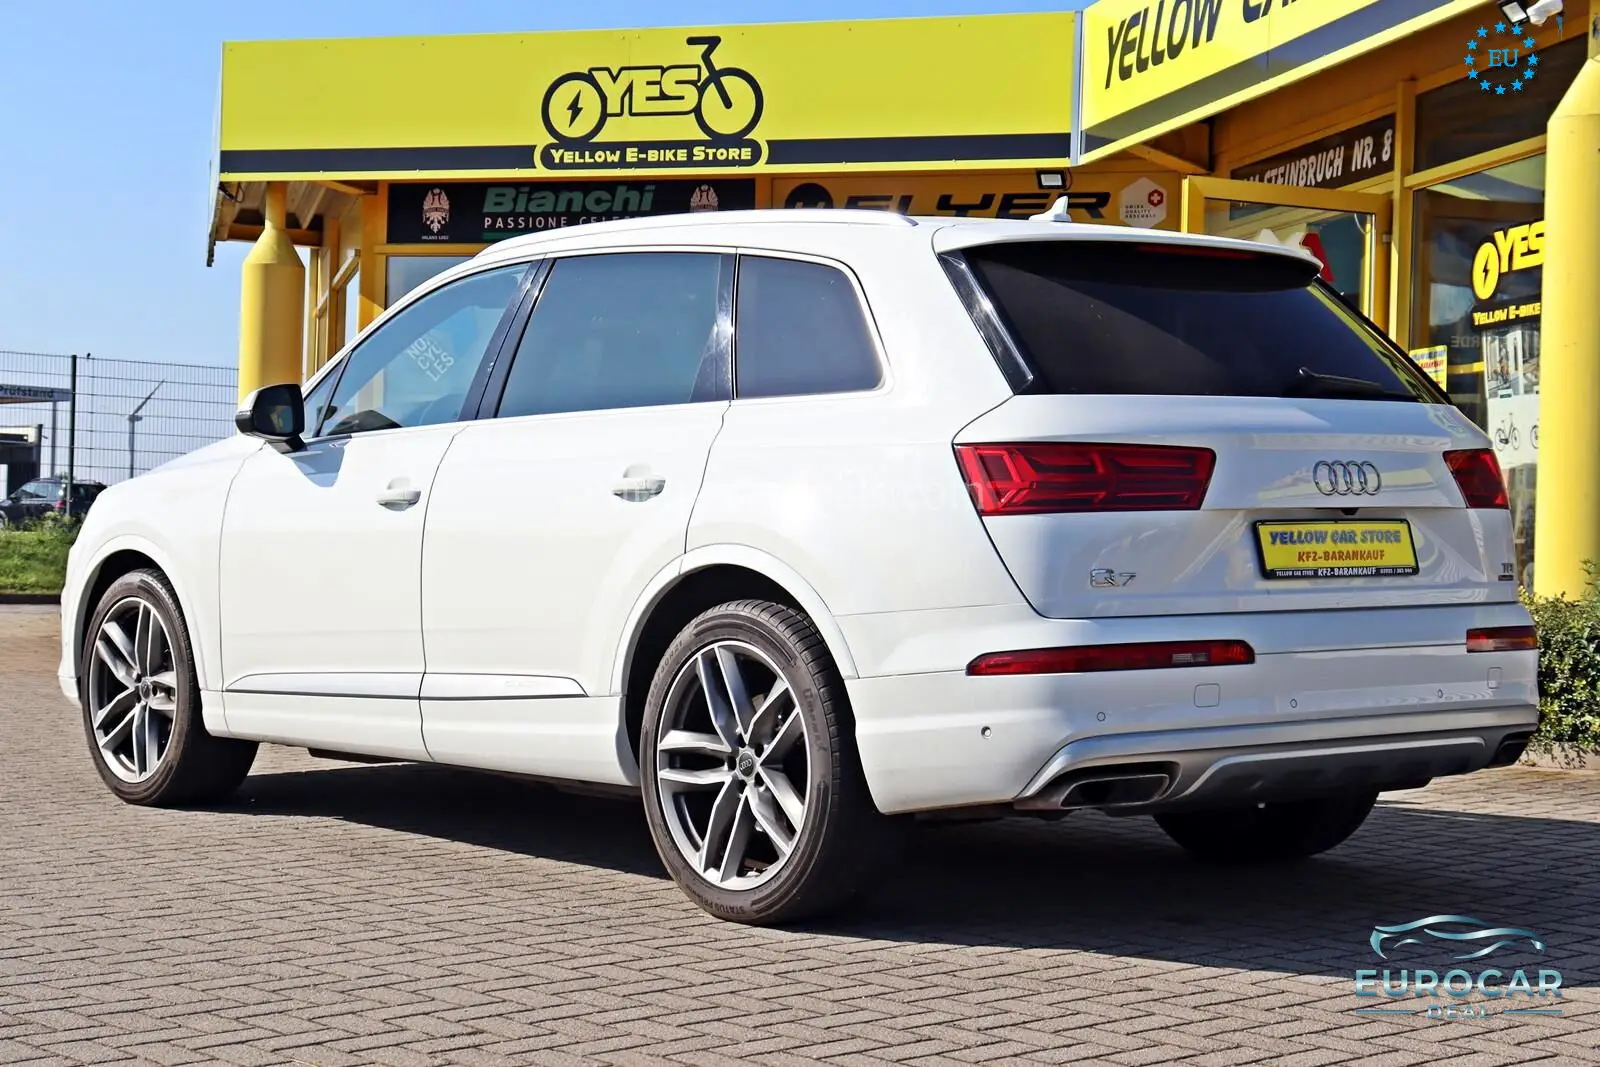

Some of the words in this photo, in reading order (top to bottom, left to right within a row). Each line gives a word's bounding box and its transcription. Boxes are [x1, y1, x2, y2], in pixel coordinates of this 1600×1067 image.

[1105, 0, 1222, 89] YELLOW
[588, 64, 700, 117] YES
[550, 148, 621, 164] YELLOW
[625, 147, 688, 162] E-BIKE
[692, 146, 752, 161] STORE
[1352, 136, 1376, 172] NR.
[1381, 128, 1393, 162] 8
[482, 184, 656, 213] Bianchi
[484, 216, 568, 229] PASSIONE
[1494, 220, 1544, 273] YES
[1473, 308, 1508, 326] YELLOW
[1508, 302, 1541, 319] E-BIKE
[1269, 531, 1328, 546] YELLOW
[1330, 530, 1357, 546] CAR
[1359, 530, 1402, 544] STORE
[1297, 549, 1385, 563] KFZ-BARANKAUF
[1090, 568, 1137, 587] Q7
